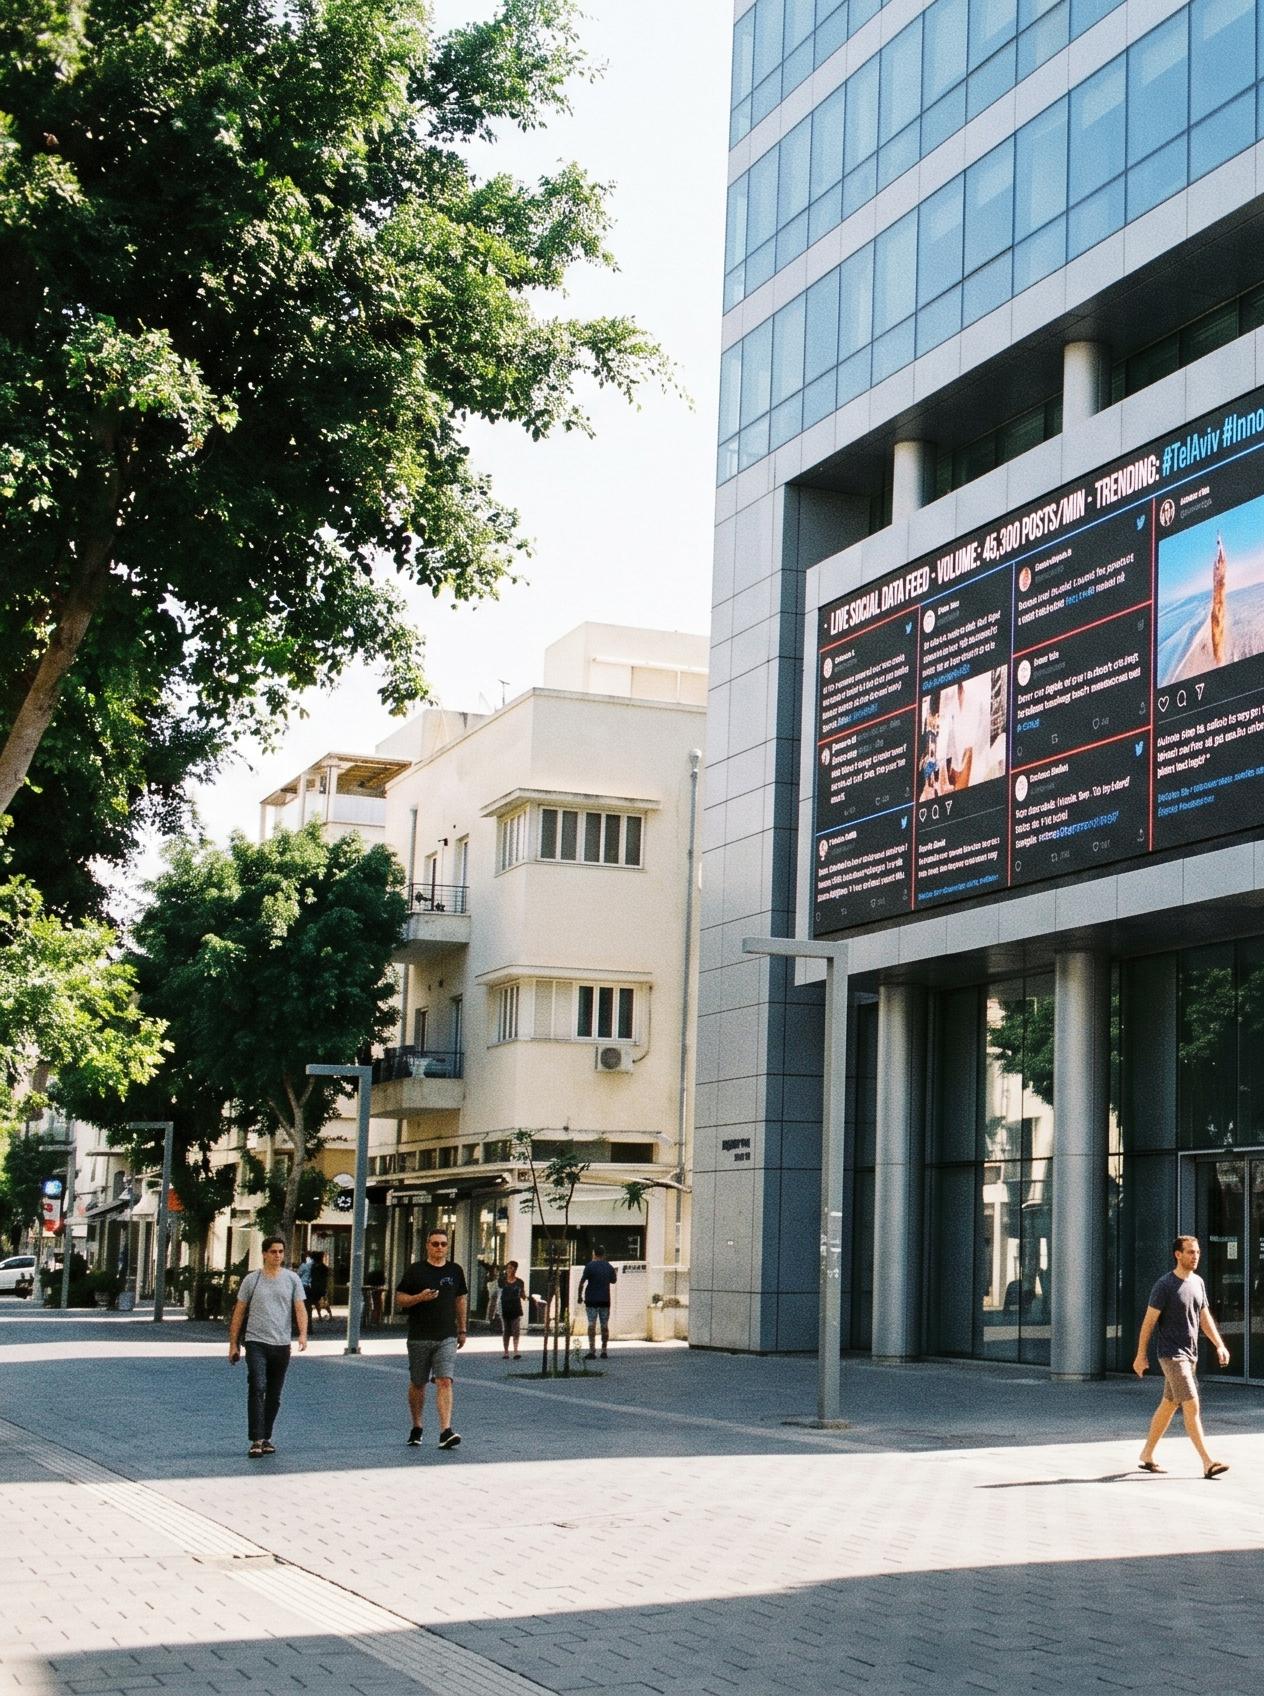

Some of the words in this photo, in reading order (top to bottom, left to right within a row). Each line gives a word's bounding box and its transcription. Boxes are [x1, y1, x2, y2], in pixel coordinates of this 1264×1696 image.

[830, 605, 849, 636] LIVE
[850, 592, 881, 627] SOCIAL
[881, 582, 903, 617] DATA
[905, 566, 930, 604] FEED
[937, 541, 981, 584] VOLUME:
[982, 521, 1020, 560] 45,300
[1021, 489, 1086, 544] POSTS/MIN
[1095, 454, 1160, 509] TRENDING:
[1162, 427, 1220, 477] #TelAviv
